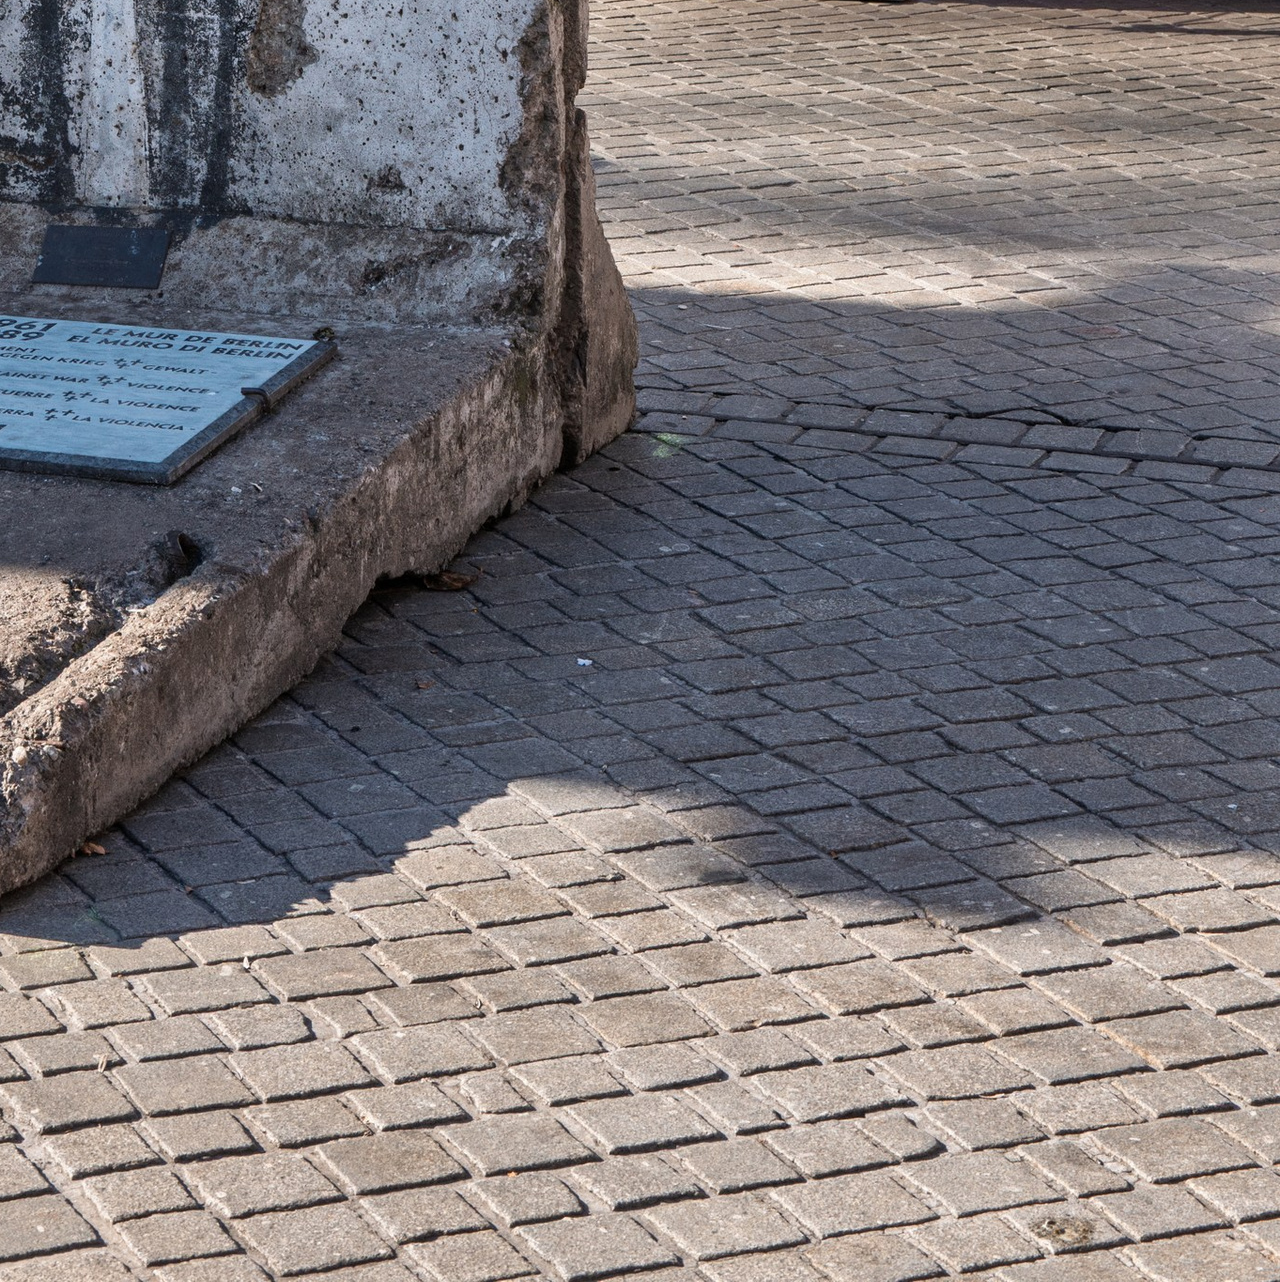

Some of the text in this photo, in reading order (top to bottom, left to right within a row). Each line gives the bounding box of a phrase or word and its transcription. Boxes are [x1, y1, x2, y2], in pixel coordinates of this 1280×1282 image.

[66, 335, 295, 361] EL MURO DI BERLIN
[91, 327, 304, 352] LE MUR DE BERLIN
[0, 352, 54, 362] GEGEN
[56, 357, 108, 366] KRIEG
[142, 364, 211, 375] GEWALT
[54, 375, 90, 384] WAR
[127, 381, 210, 394] VIOLENCE
[89, 397, 110, 405] LA
[117, 399, 201, 413] VIOLENCE
[99, 417, 184, 431] VIOLENCIA
